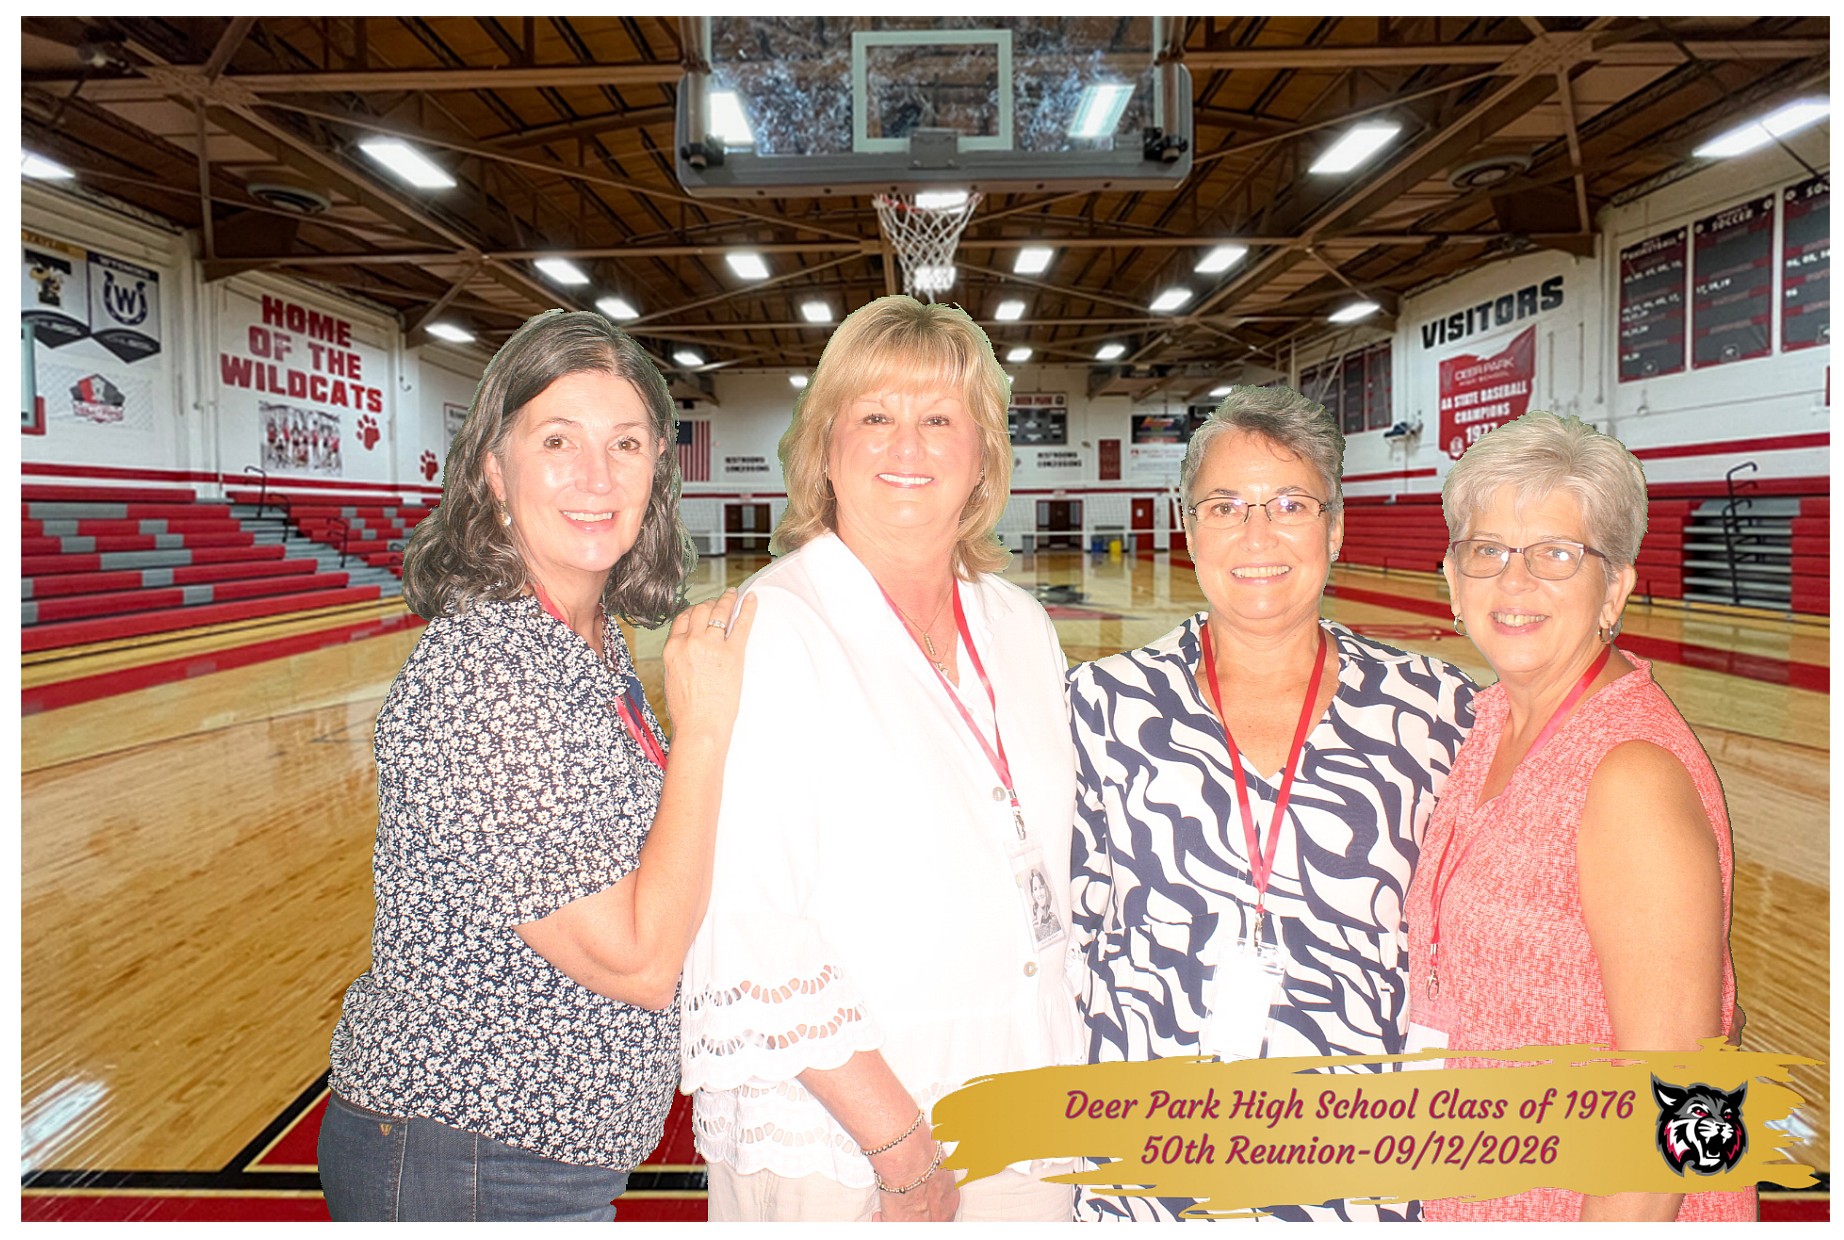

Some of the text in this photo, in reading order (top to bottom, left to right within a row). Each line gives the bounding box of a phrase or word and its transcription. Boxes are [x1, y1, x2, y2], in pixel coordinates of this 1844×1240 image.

[1711, 208, 1753, 232] SOCCER
[262, 294, 351, 348] HOME
[1421, 275, 1564, 350] VISITORS
[249, 325, 361, 380] OF THE
[1483, 356, 1515, 373] PARK
[220, 353, 382, 413] WILDCATS
[1441, 380, 1527, 411] AA STATE BASEBALL
[1454, 402, 1511, 425] CHAMPIONS
